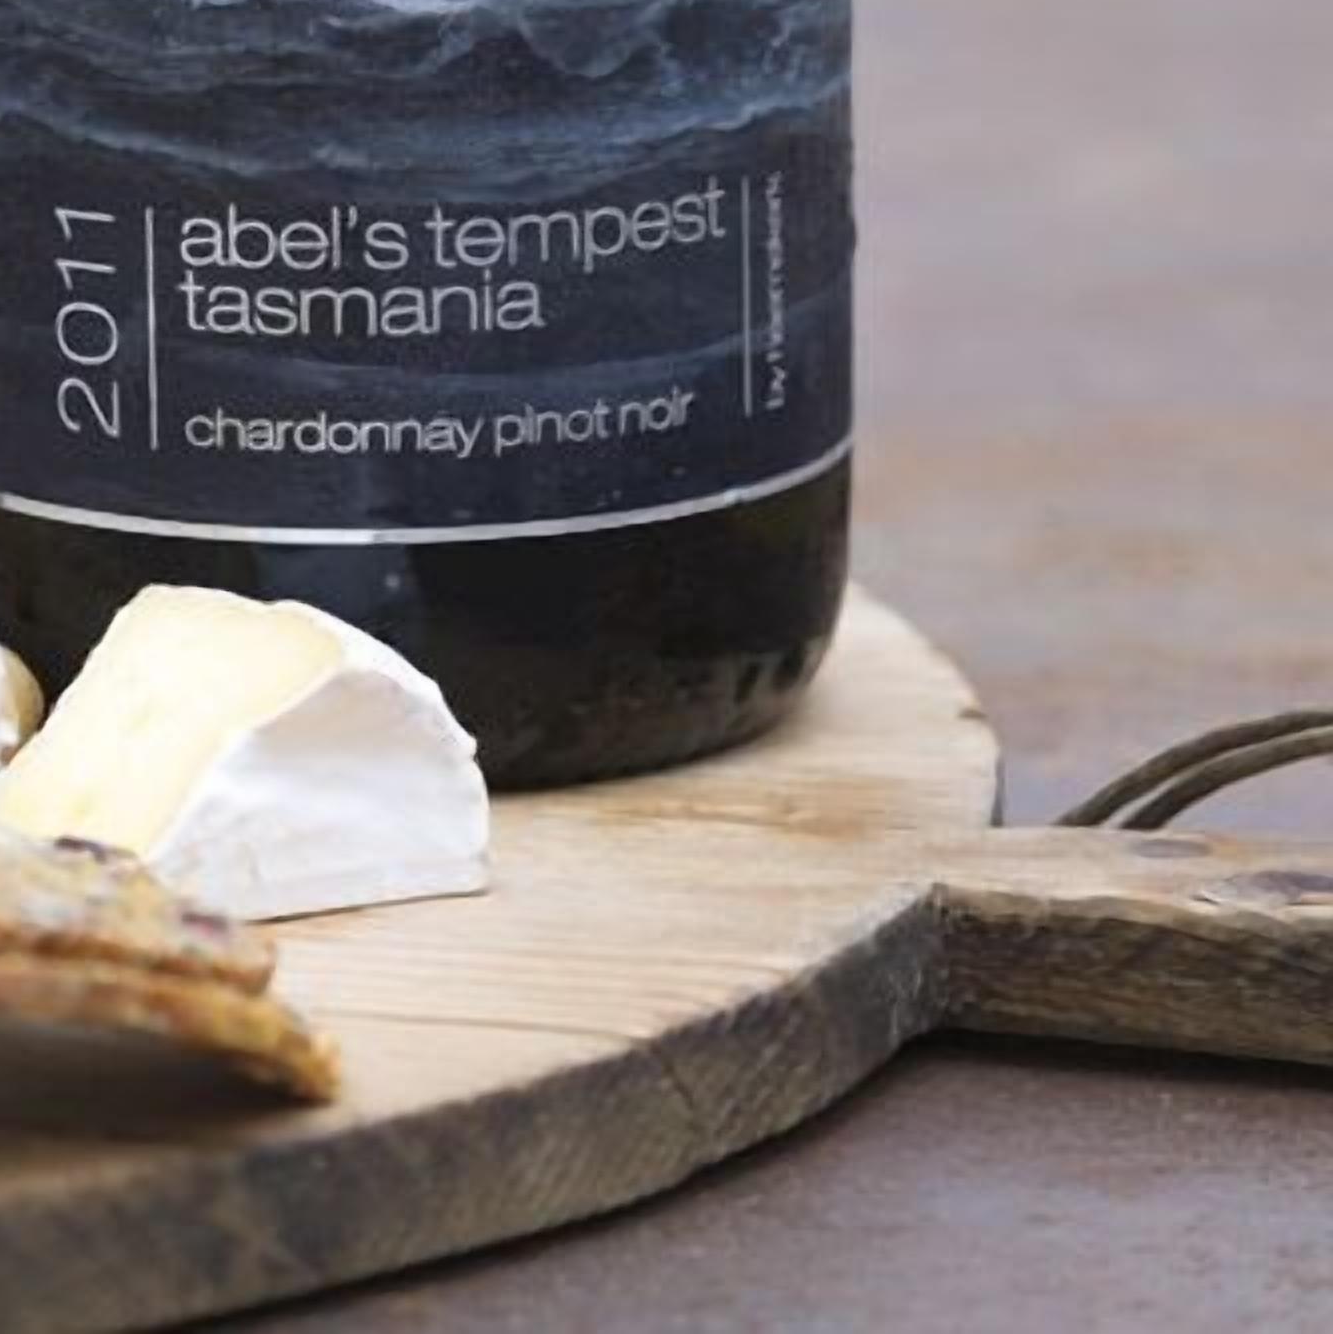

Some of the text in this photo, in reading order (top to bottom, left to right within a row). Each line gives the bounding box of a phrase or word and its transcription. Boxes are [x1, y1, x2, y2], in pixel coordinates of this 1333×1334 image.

[178, 203, 409, 270] abel's
[424, 176, 727, 272] tempest
[54, 205, 120, 438] 2011
[178, 270, 546, 336] tasmania
[184, 384, 695, 458] chardonnay pinot noir
